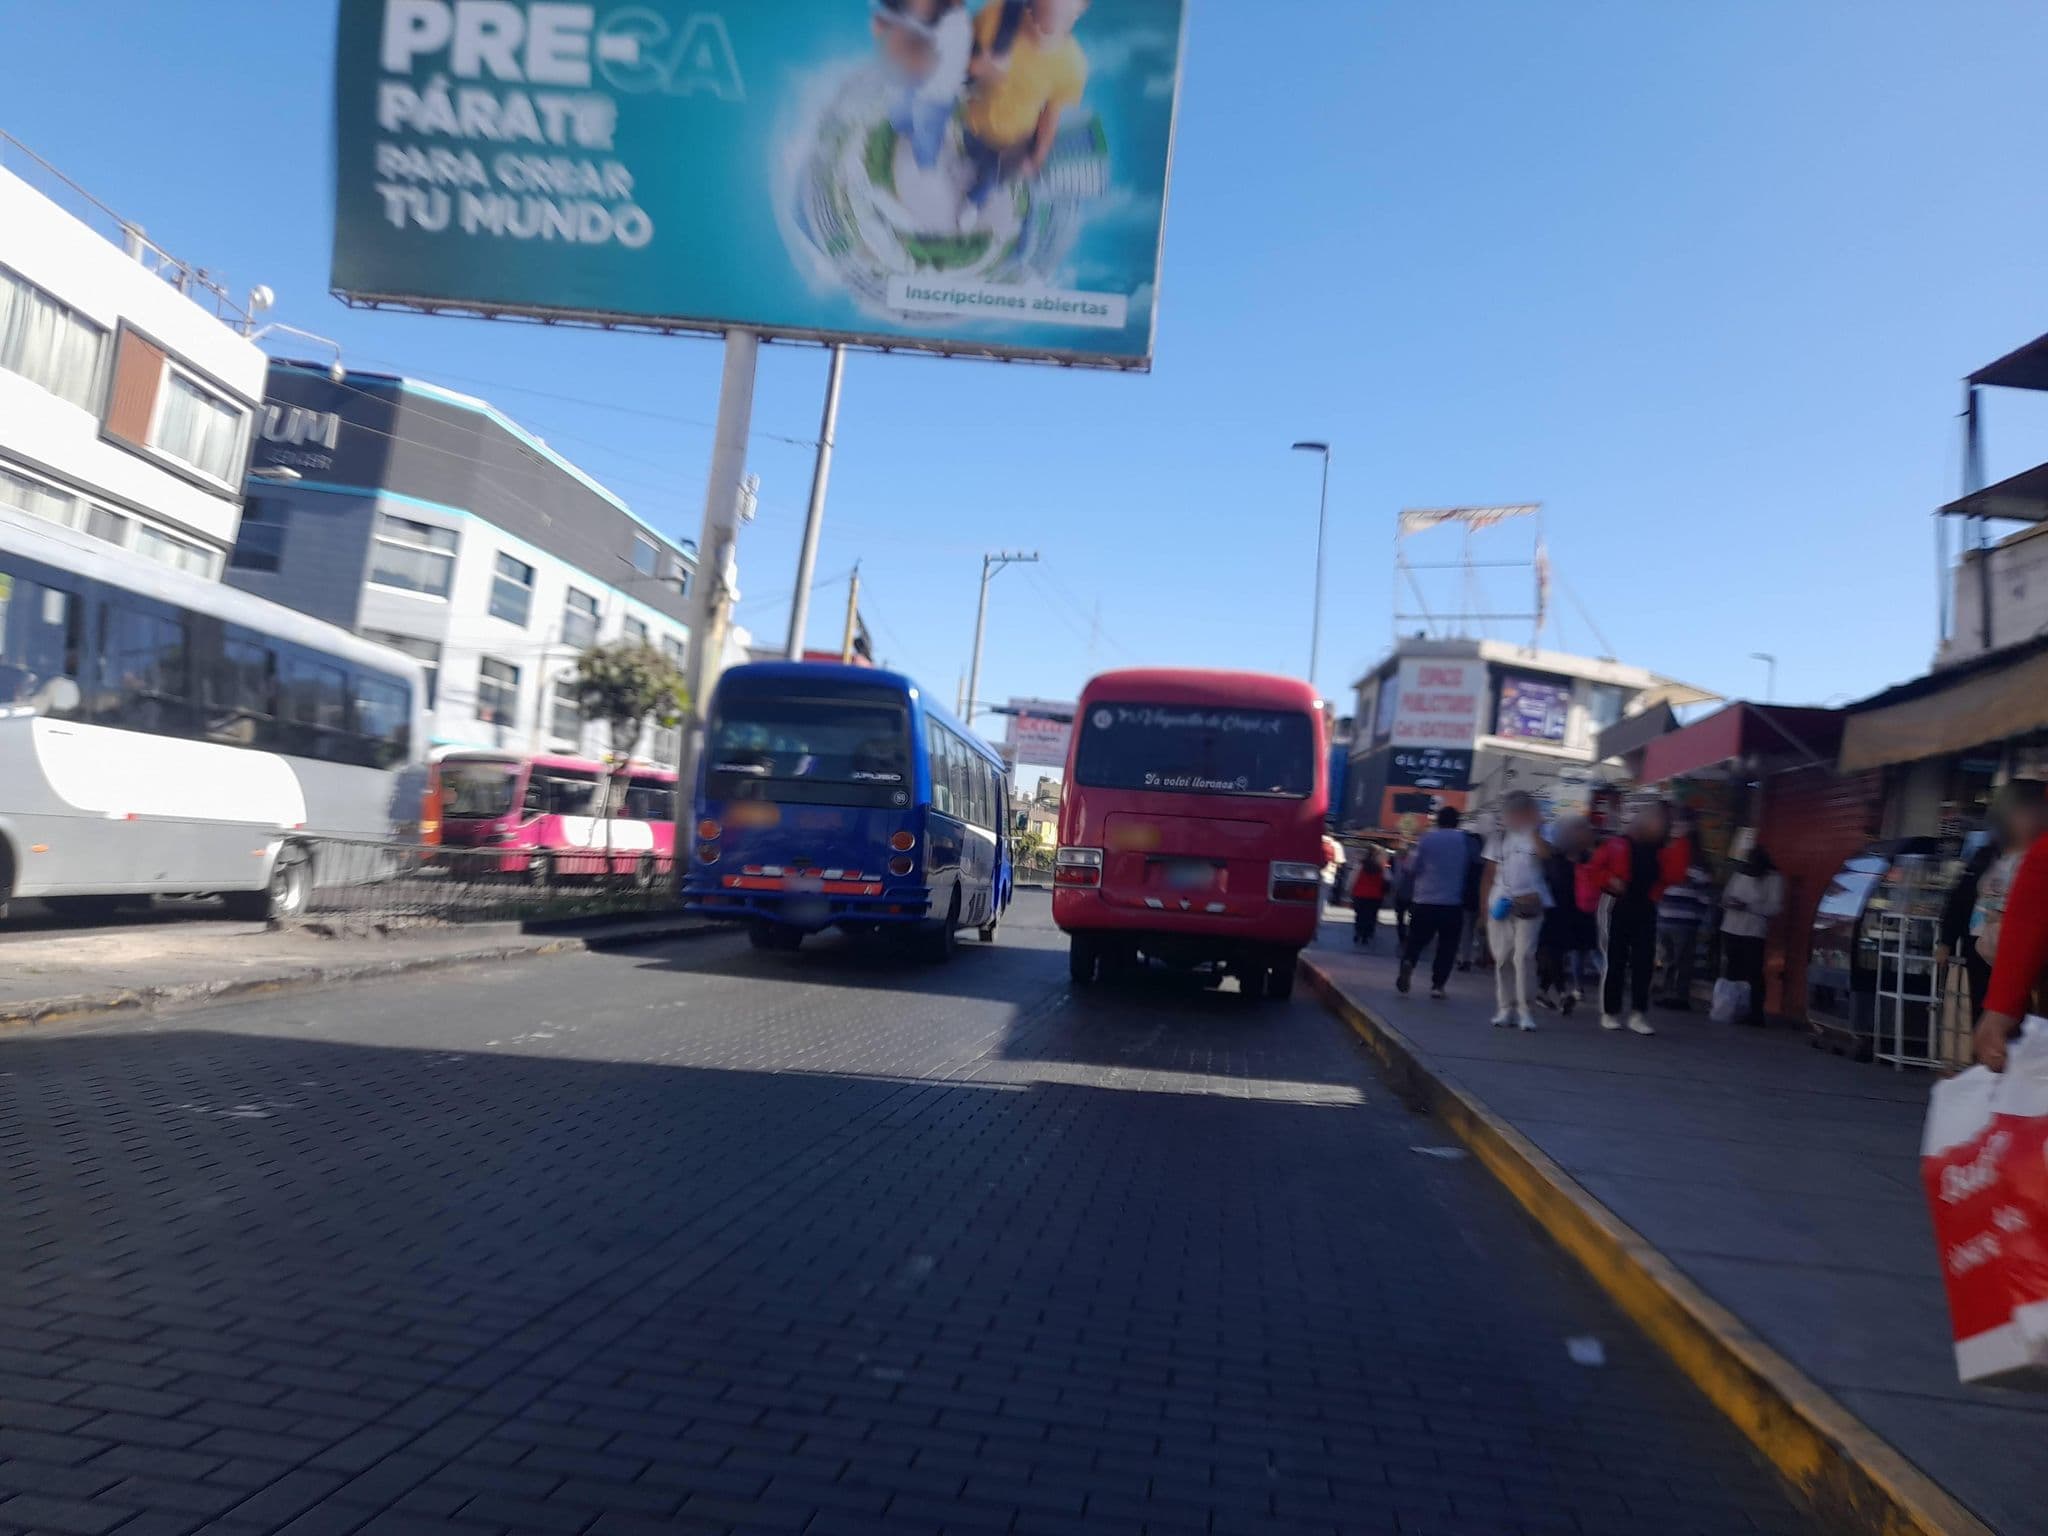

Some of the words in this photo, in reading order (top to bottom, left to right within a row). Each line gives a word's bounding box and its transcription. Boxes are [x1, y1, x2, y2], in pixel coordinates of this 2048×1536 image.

[377, 72, 617, 151] PÁRATE
[375, 142, 489, 188] PARA
[494, 151, 634, 200] CREAR
[375, 182, 450, 231] TU
[459, 189, 654, 249] MUNDO
[905, 285, 1026, 310] Inscripciones
[1031, 296, 1109, 317] abiertas
